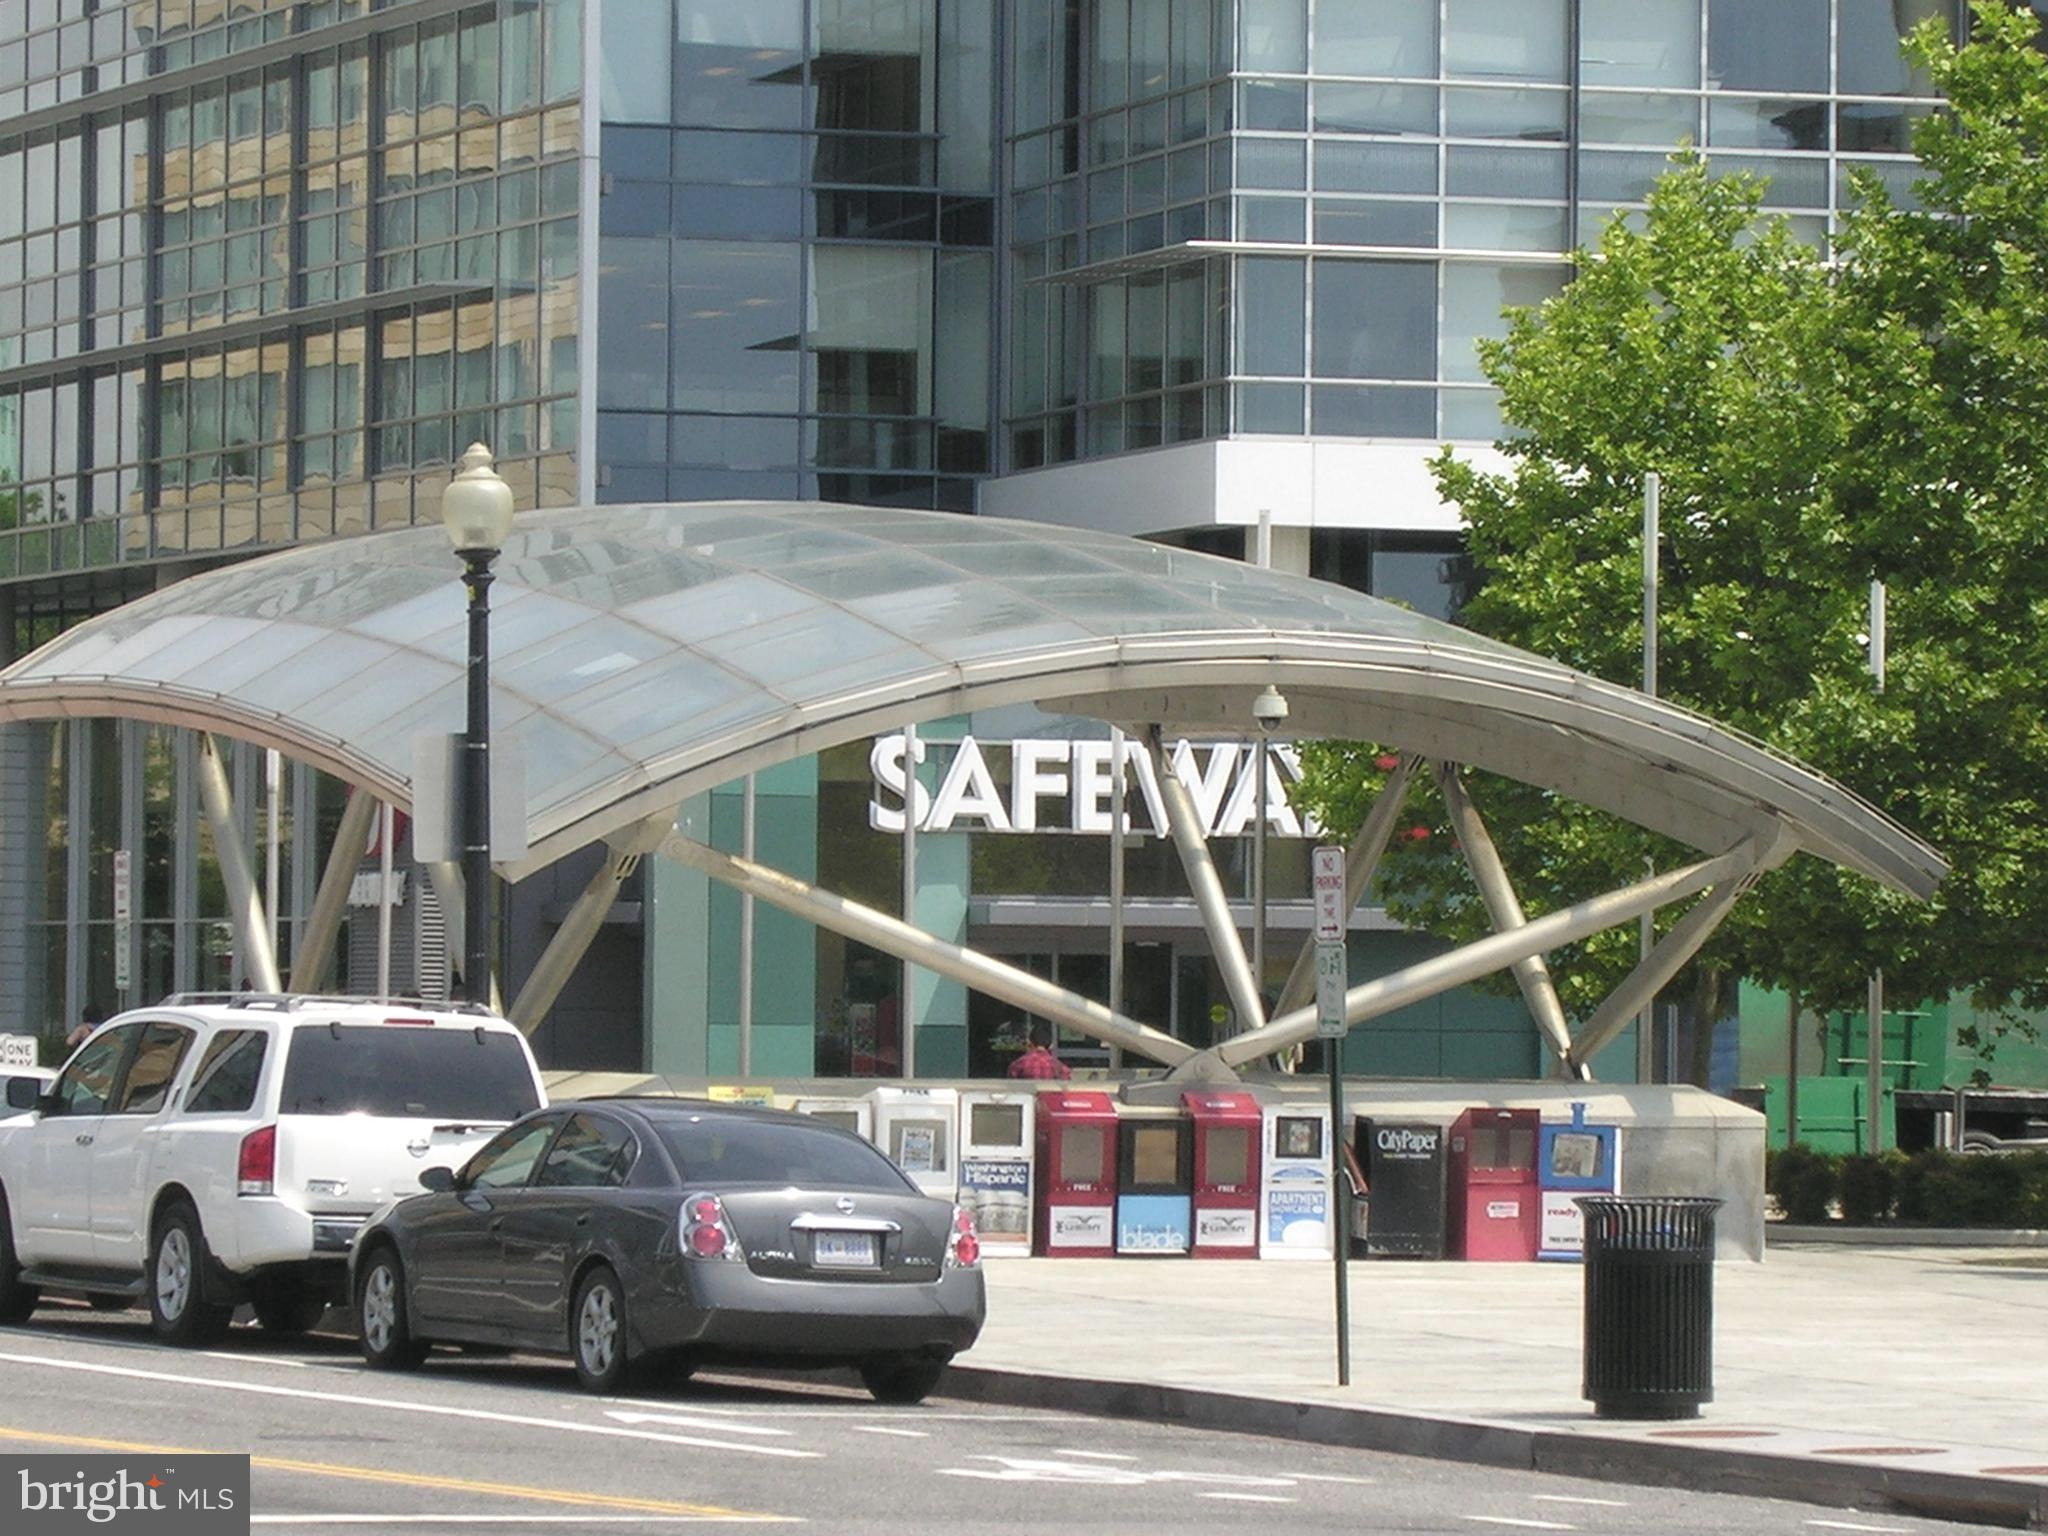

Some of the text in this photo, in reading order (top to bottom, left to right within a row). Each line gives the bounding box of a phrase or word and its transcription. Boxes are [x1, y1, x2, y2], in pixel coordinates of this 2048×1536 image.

[7, 1043, 31, 1056] ONE
[964, 1162, 1027, 1177] Washington
[965, 1171, 1026, 1185] Hispanic
[1270, 1192, 1325, 1205] APARTMENT
[1547, 1208, 1578, 1218] ready
[1121, 1223, 1185, 1249] blade
